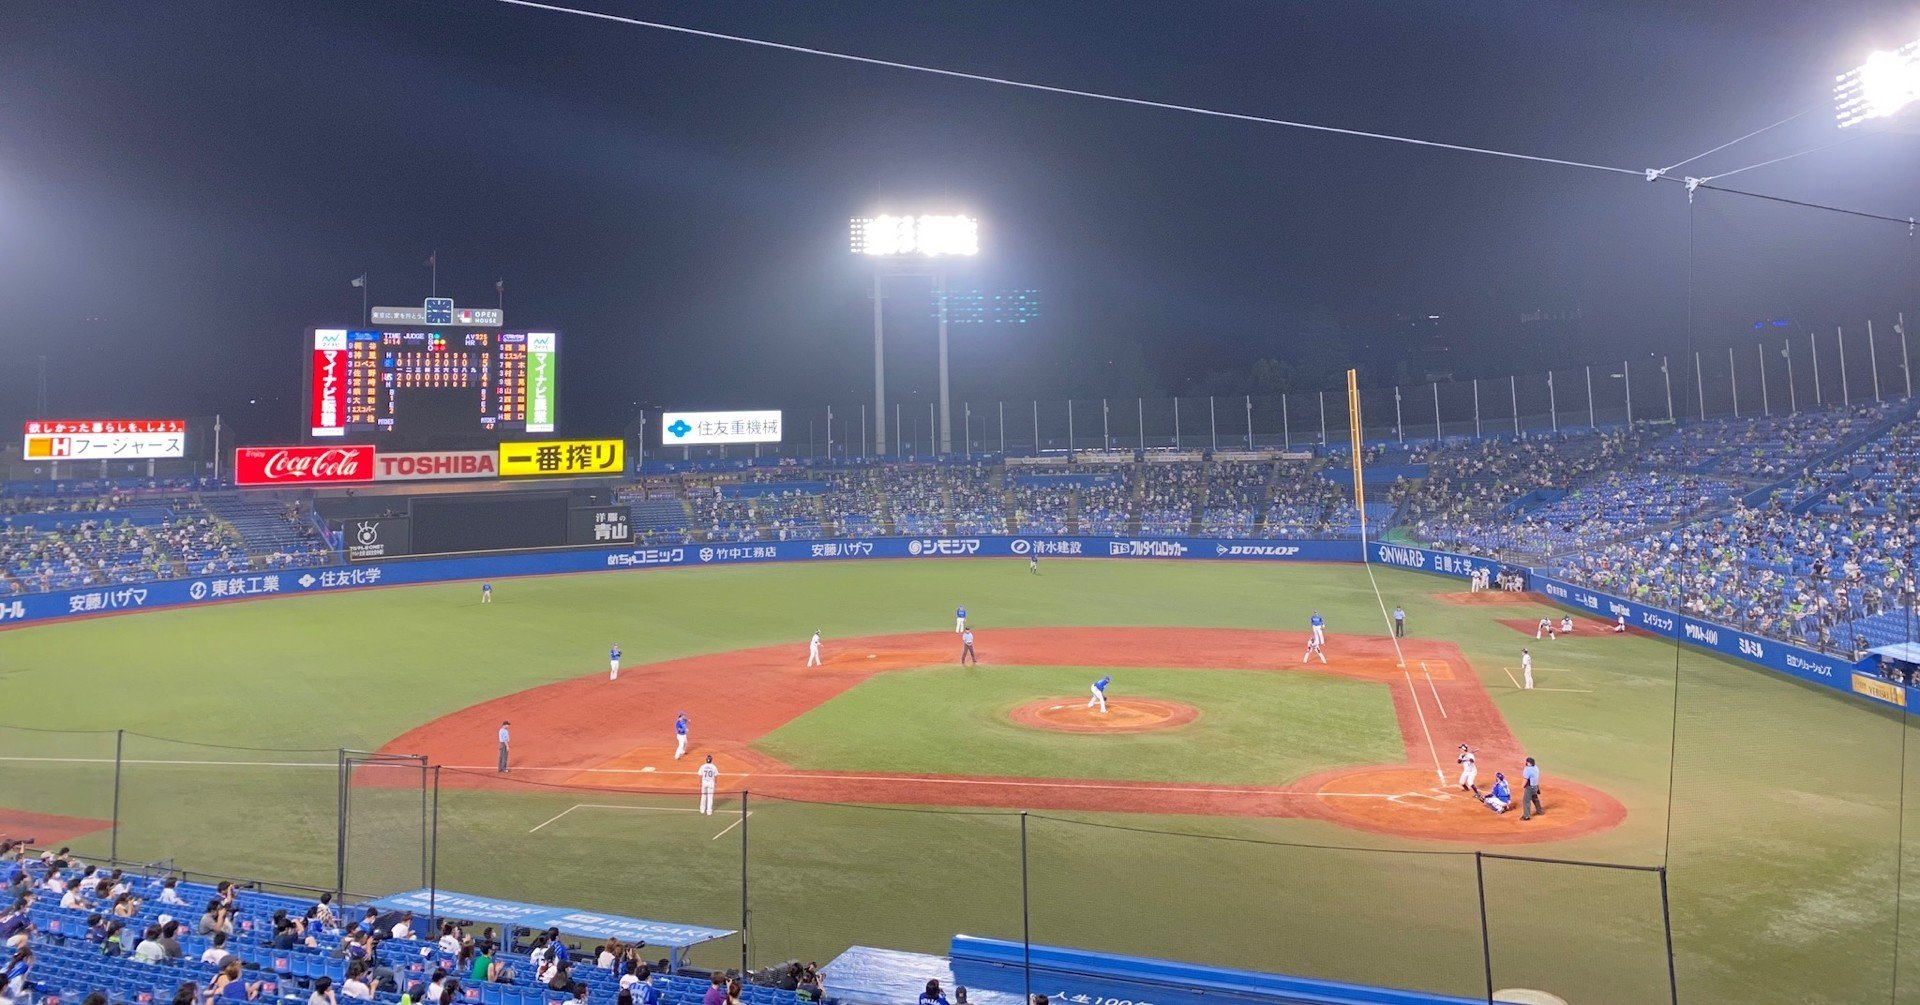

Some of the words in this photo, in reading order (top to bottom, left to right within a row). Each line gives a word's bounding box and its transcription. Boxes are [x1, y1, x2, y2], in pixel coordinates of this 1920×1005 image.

[28, 422, 184, 433] 欲しかった暮らしを、しよう。
[698, 420, 778, 436] 住友重機械
[52, 438, 69, 456] H
[76, 438, 180, 454] フージャース
[245, 449, 266, 458] Enjoy
[264, 449, 360, 478] Coca-Cola
[380, 455, 494, 475] TOSHIBA
[508, 445, 615, 471] 一番搾り
[595, 513, 626, 522] 洋服の
[594, 523, 628, 540] 青山
[716, 547, 777, 559] 竹中工務店
[811, 542, 873, 556] 安藤ハザマ
[923, 539, 980, 554] シモジマ
[1033, 540, 1082, 555] 清水建設
[1110, 542, 1129, 555] FTS
[1130, 541, 1188, 556] フルタイムロッカー
[1229, 545, 1299, 555] DUNLOP
[607, 548, 684, 566] めちゃコミック
[1379, 546, 1425, 567] ONWARD
[211, 575, 280, 597] 東鉄工業
[319, 568, 381, 587] 住友化学
[69, 589, 148, 612] 安藤ハザマ
[1643, 613, 1673, 630] エイジェック
[1739, 638, 1764, 658] ミルミル
[1787, 654, 1832, 677] 日立ソリューションズ
[444, 898, 548, 914] IWASAKI
[600, 919, 712, 937] IWASAKI
